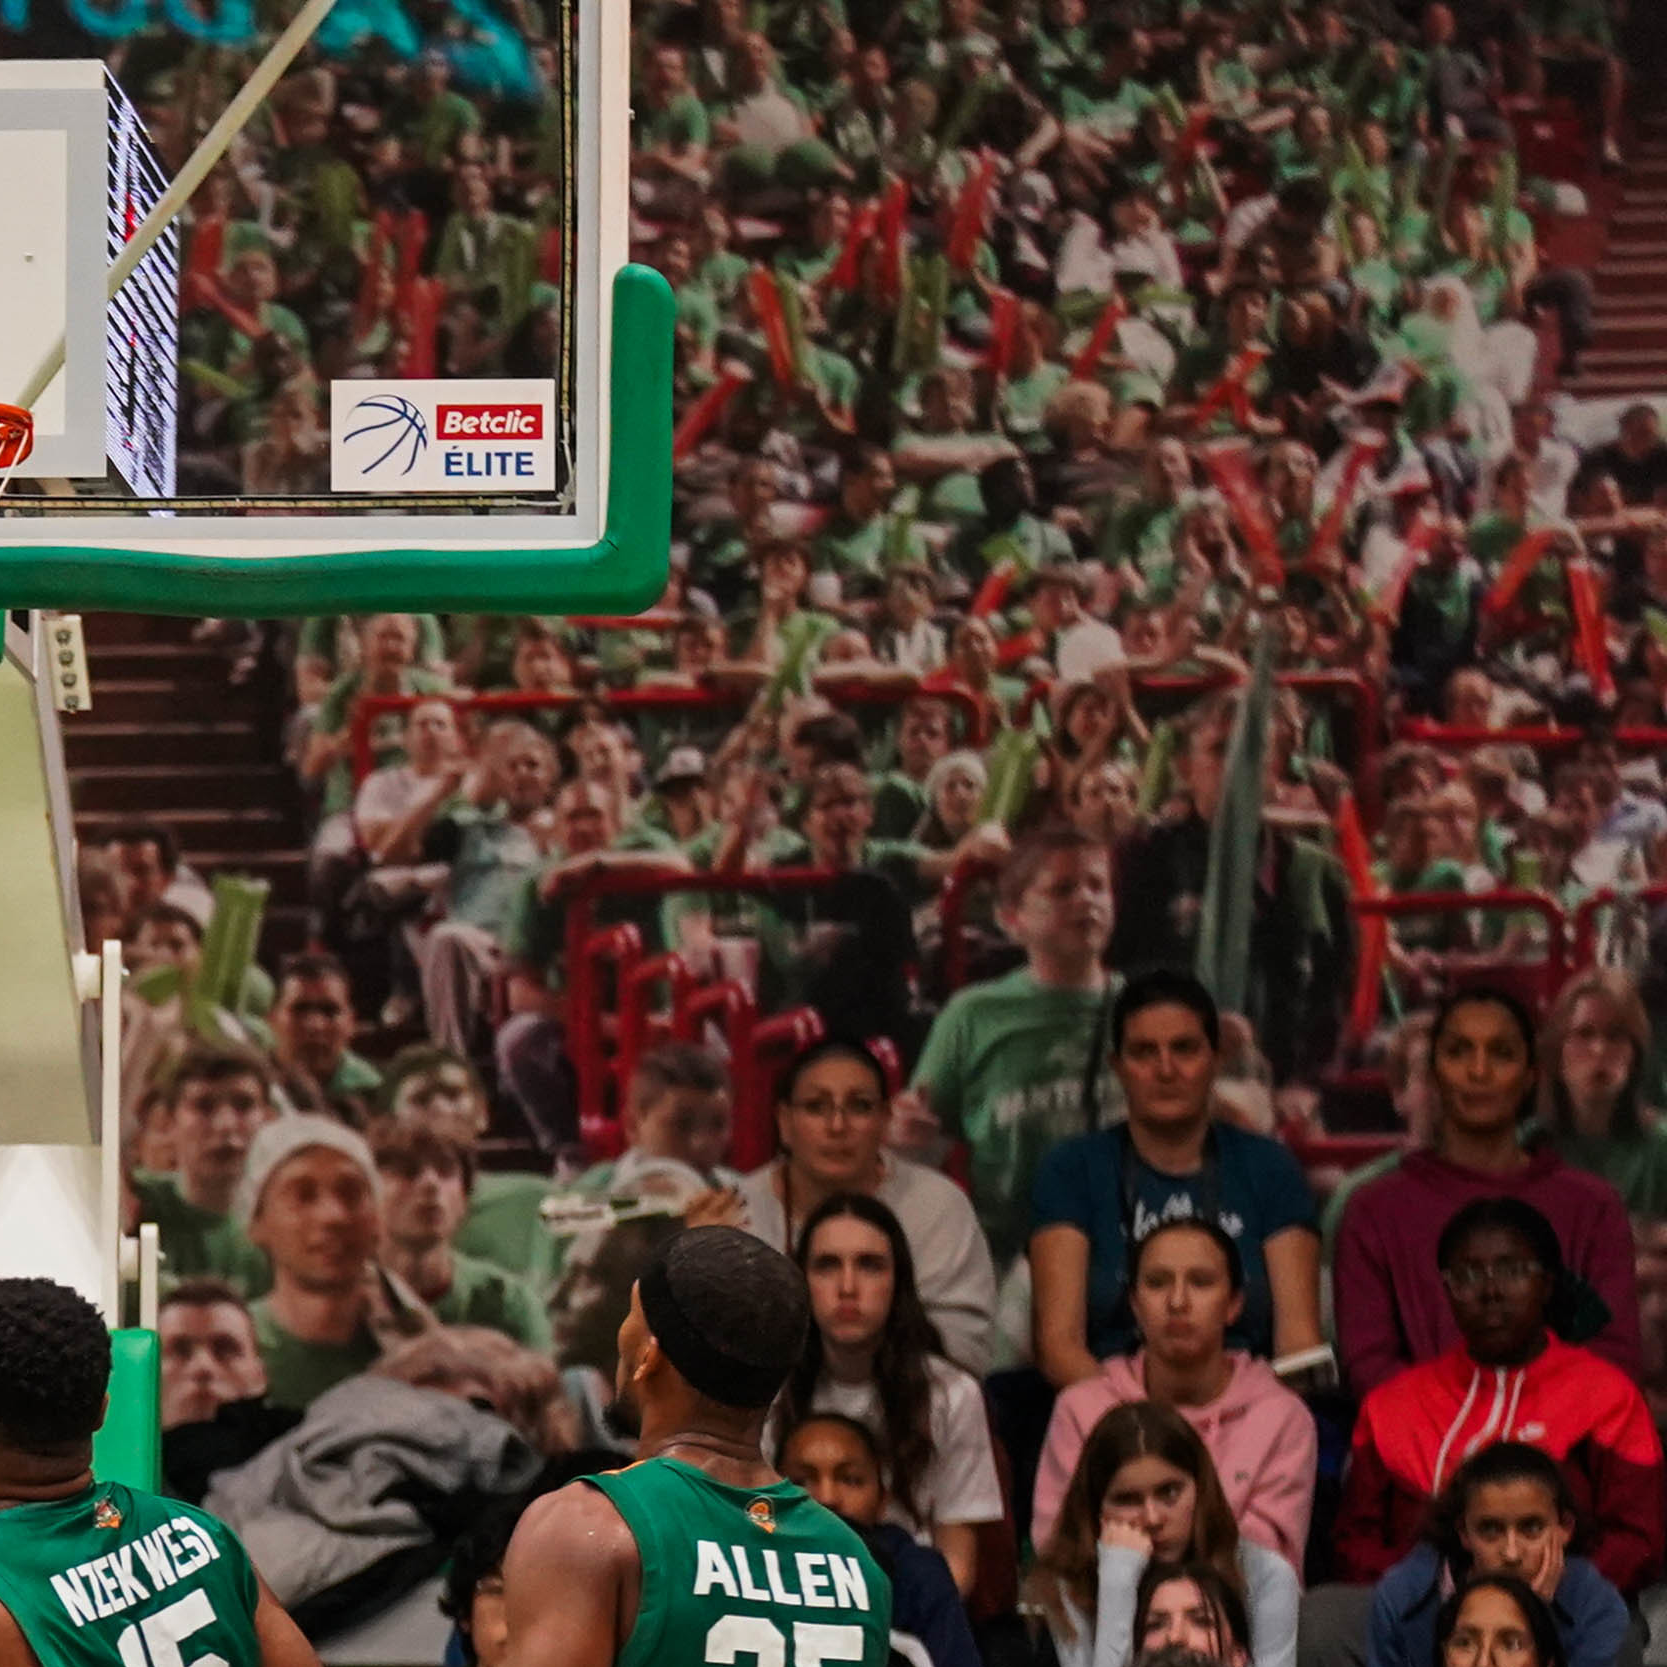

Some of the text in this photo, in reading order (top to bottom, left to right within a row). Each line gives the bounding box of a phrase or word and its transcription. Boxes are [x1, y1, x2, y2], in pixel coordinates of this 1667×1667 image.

[443, 410, 536, 435] Betclic
[444, 445, 535, 477] ÉLITE
[693, 1539, 871, 1612] ALLEN
